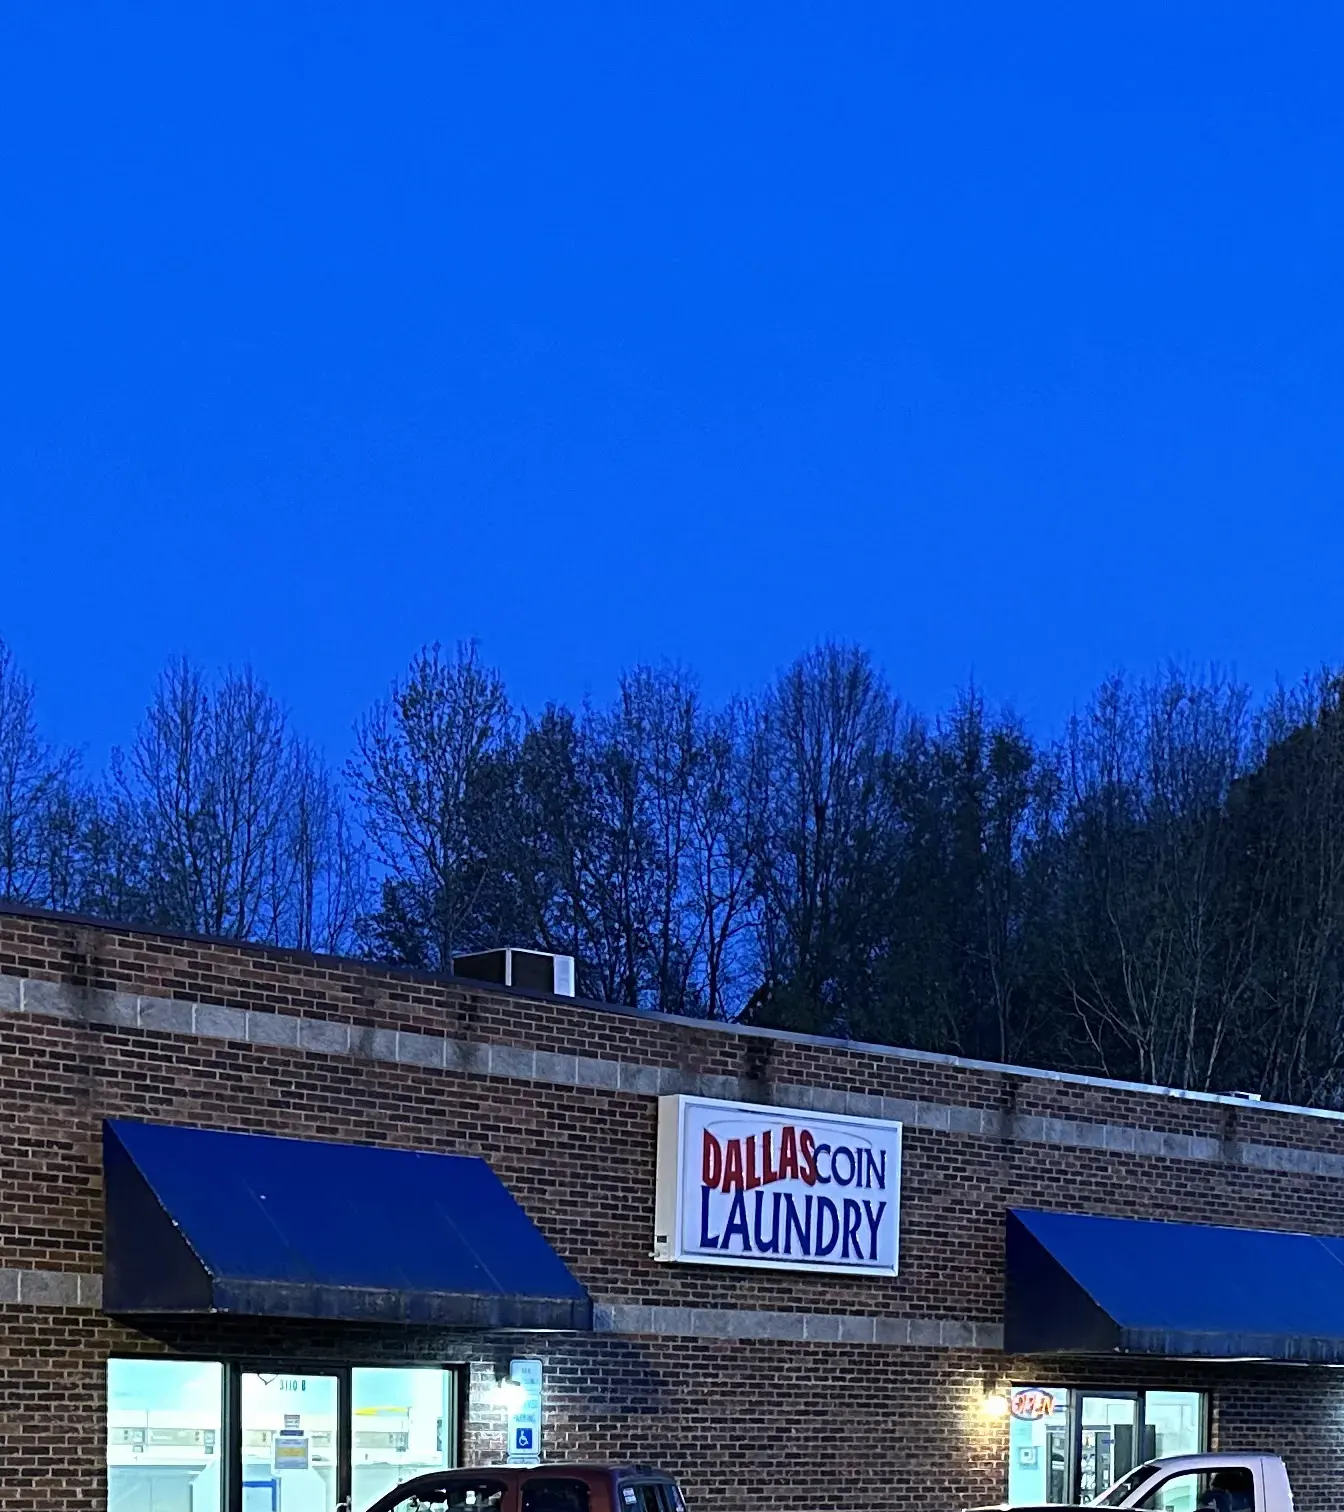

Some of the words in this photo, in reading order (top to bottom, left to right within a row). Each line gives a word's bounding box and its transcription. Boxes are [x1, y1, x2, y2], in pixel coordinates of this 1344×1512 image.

[702, 1126, 818, 1193] DALLAS
[815, 1143, 886, 1190] COIN
[699, 1185, 887, 1261] LAUNDRY
[1012, 1394, 1055, 1416] OPEN
